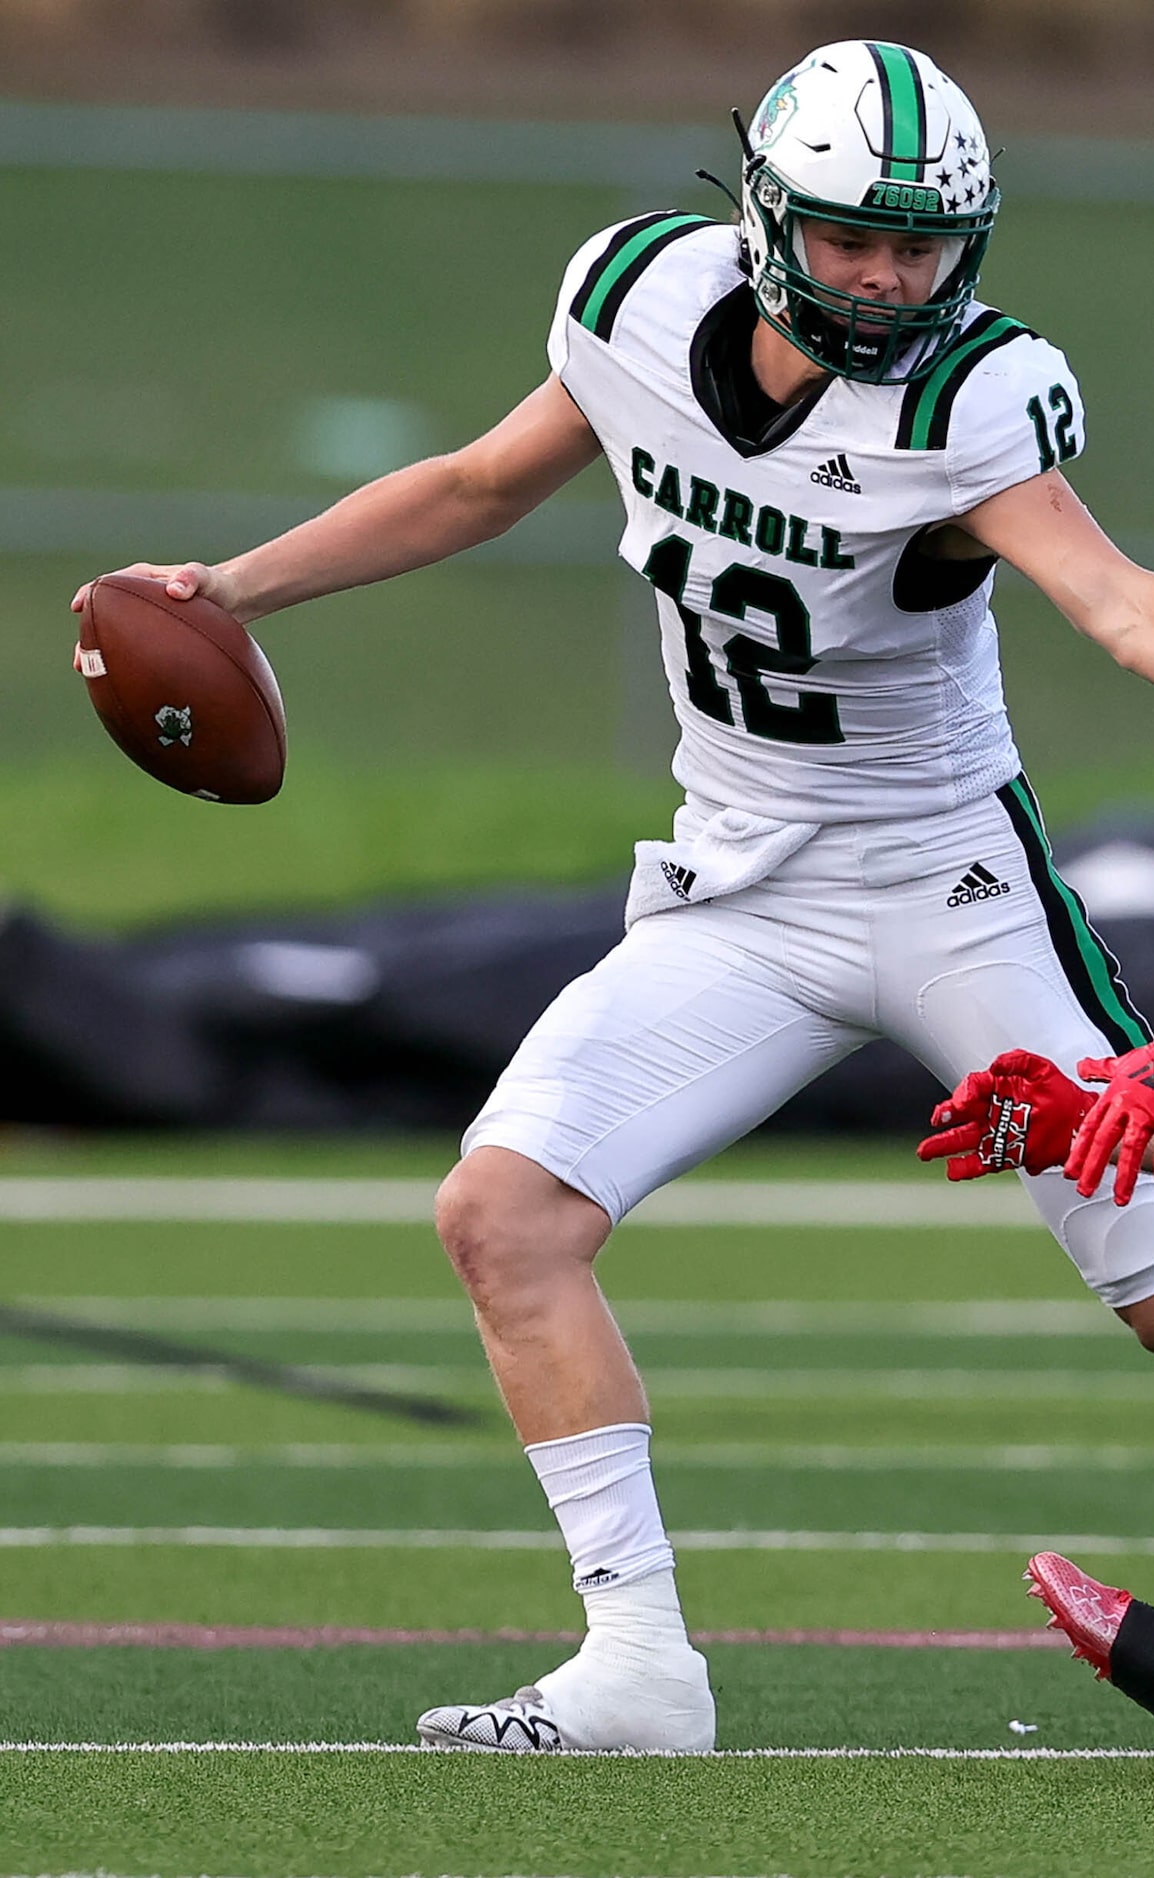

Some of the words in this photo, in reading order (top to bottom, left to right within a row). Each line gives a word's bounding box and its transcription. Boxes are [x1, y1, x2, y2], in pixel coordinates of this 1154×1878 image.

[872, 183, 940, 212] 76092
[1026, 382, 1077, 473] 12
[631, 446, 855, 569] CARROLL
[810, 471, 861, 494] adidas
[641, 534, 846, 744] 12
[946, 882, 1010, 907] adidas
